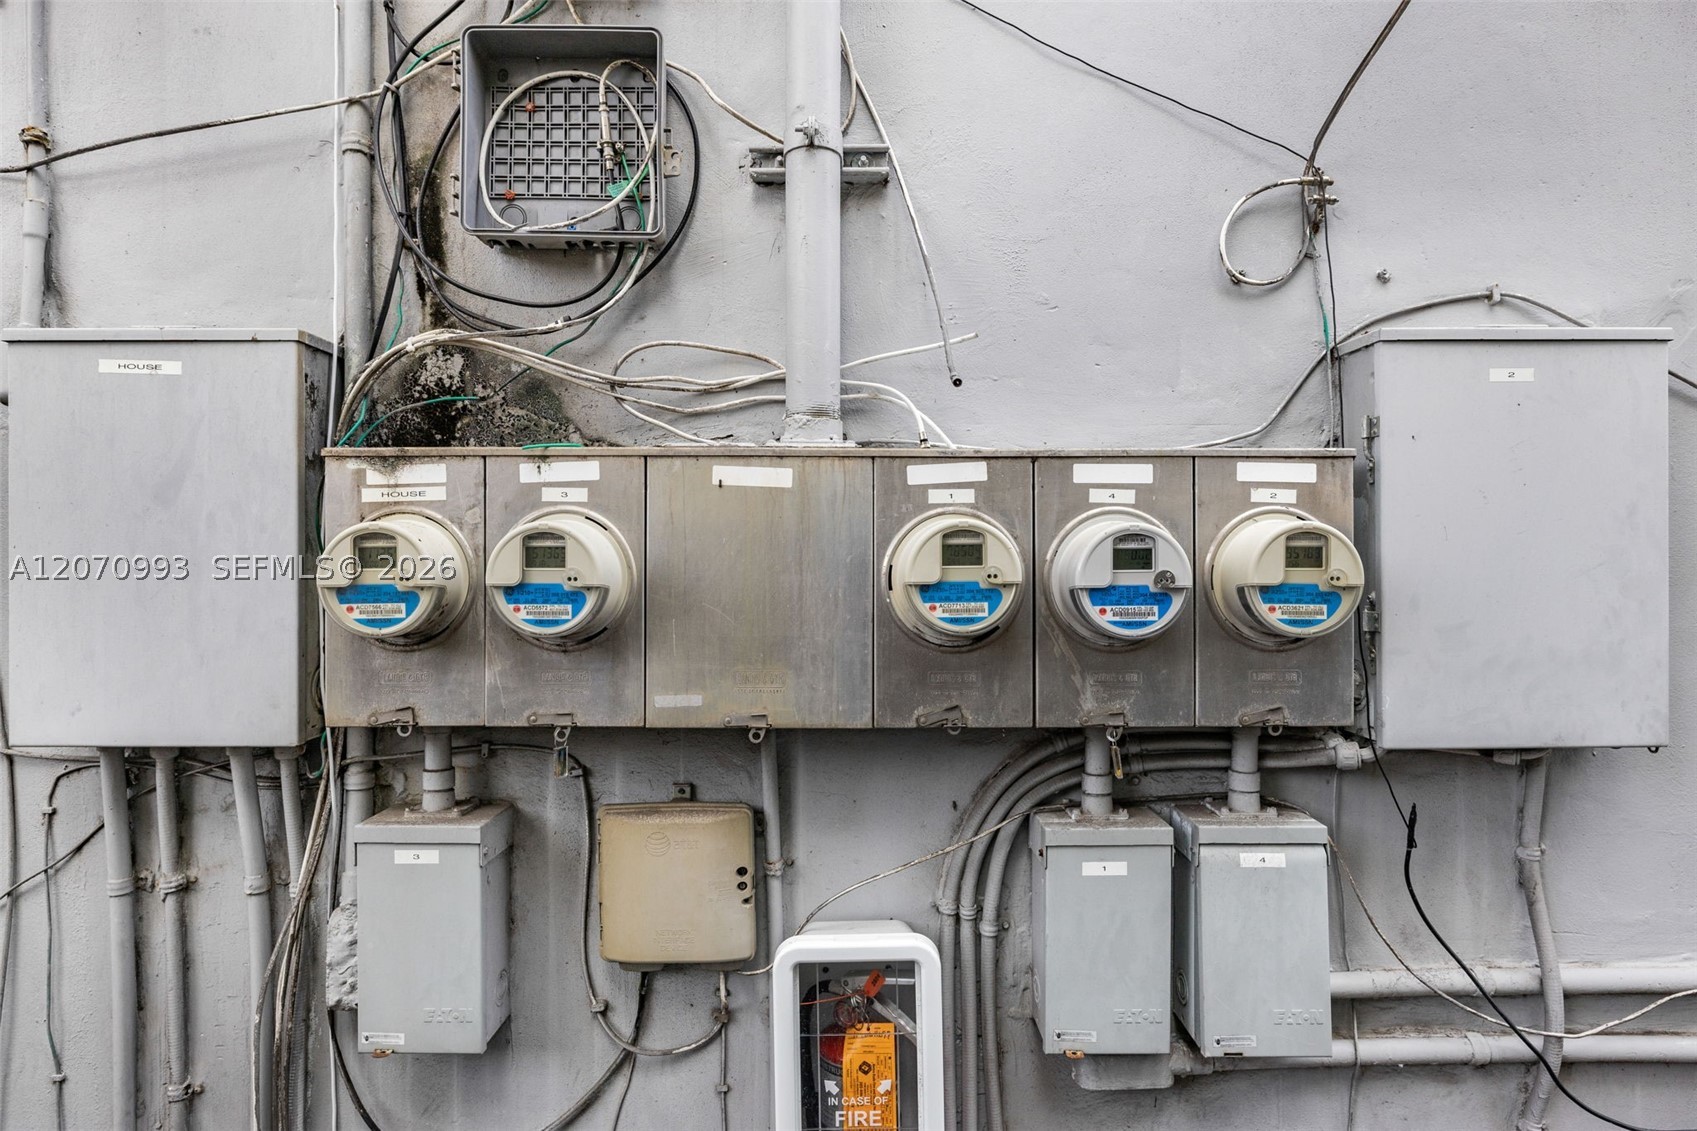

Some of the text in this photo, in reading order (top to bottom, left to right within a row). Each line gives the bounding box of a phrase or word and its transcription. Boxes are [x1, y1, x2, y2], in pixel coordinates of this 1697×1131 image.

[117, 363, 163, 371] HOUSE
[1507, 371, 1516, 379] 2
[381, 489, 427, 498] HOUSE
[560, 491, 569, 499] 3
[1259, 856, 1267, 864] 4
[828, 1096, 889, 1106] IN CASE OF
[835, 1110, 882, 1127] FIRE
